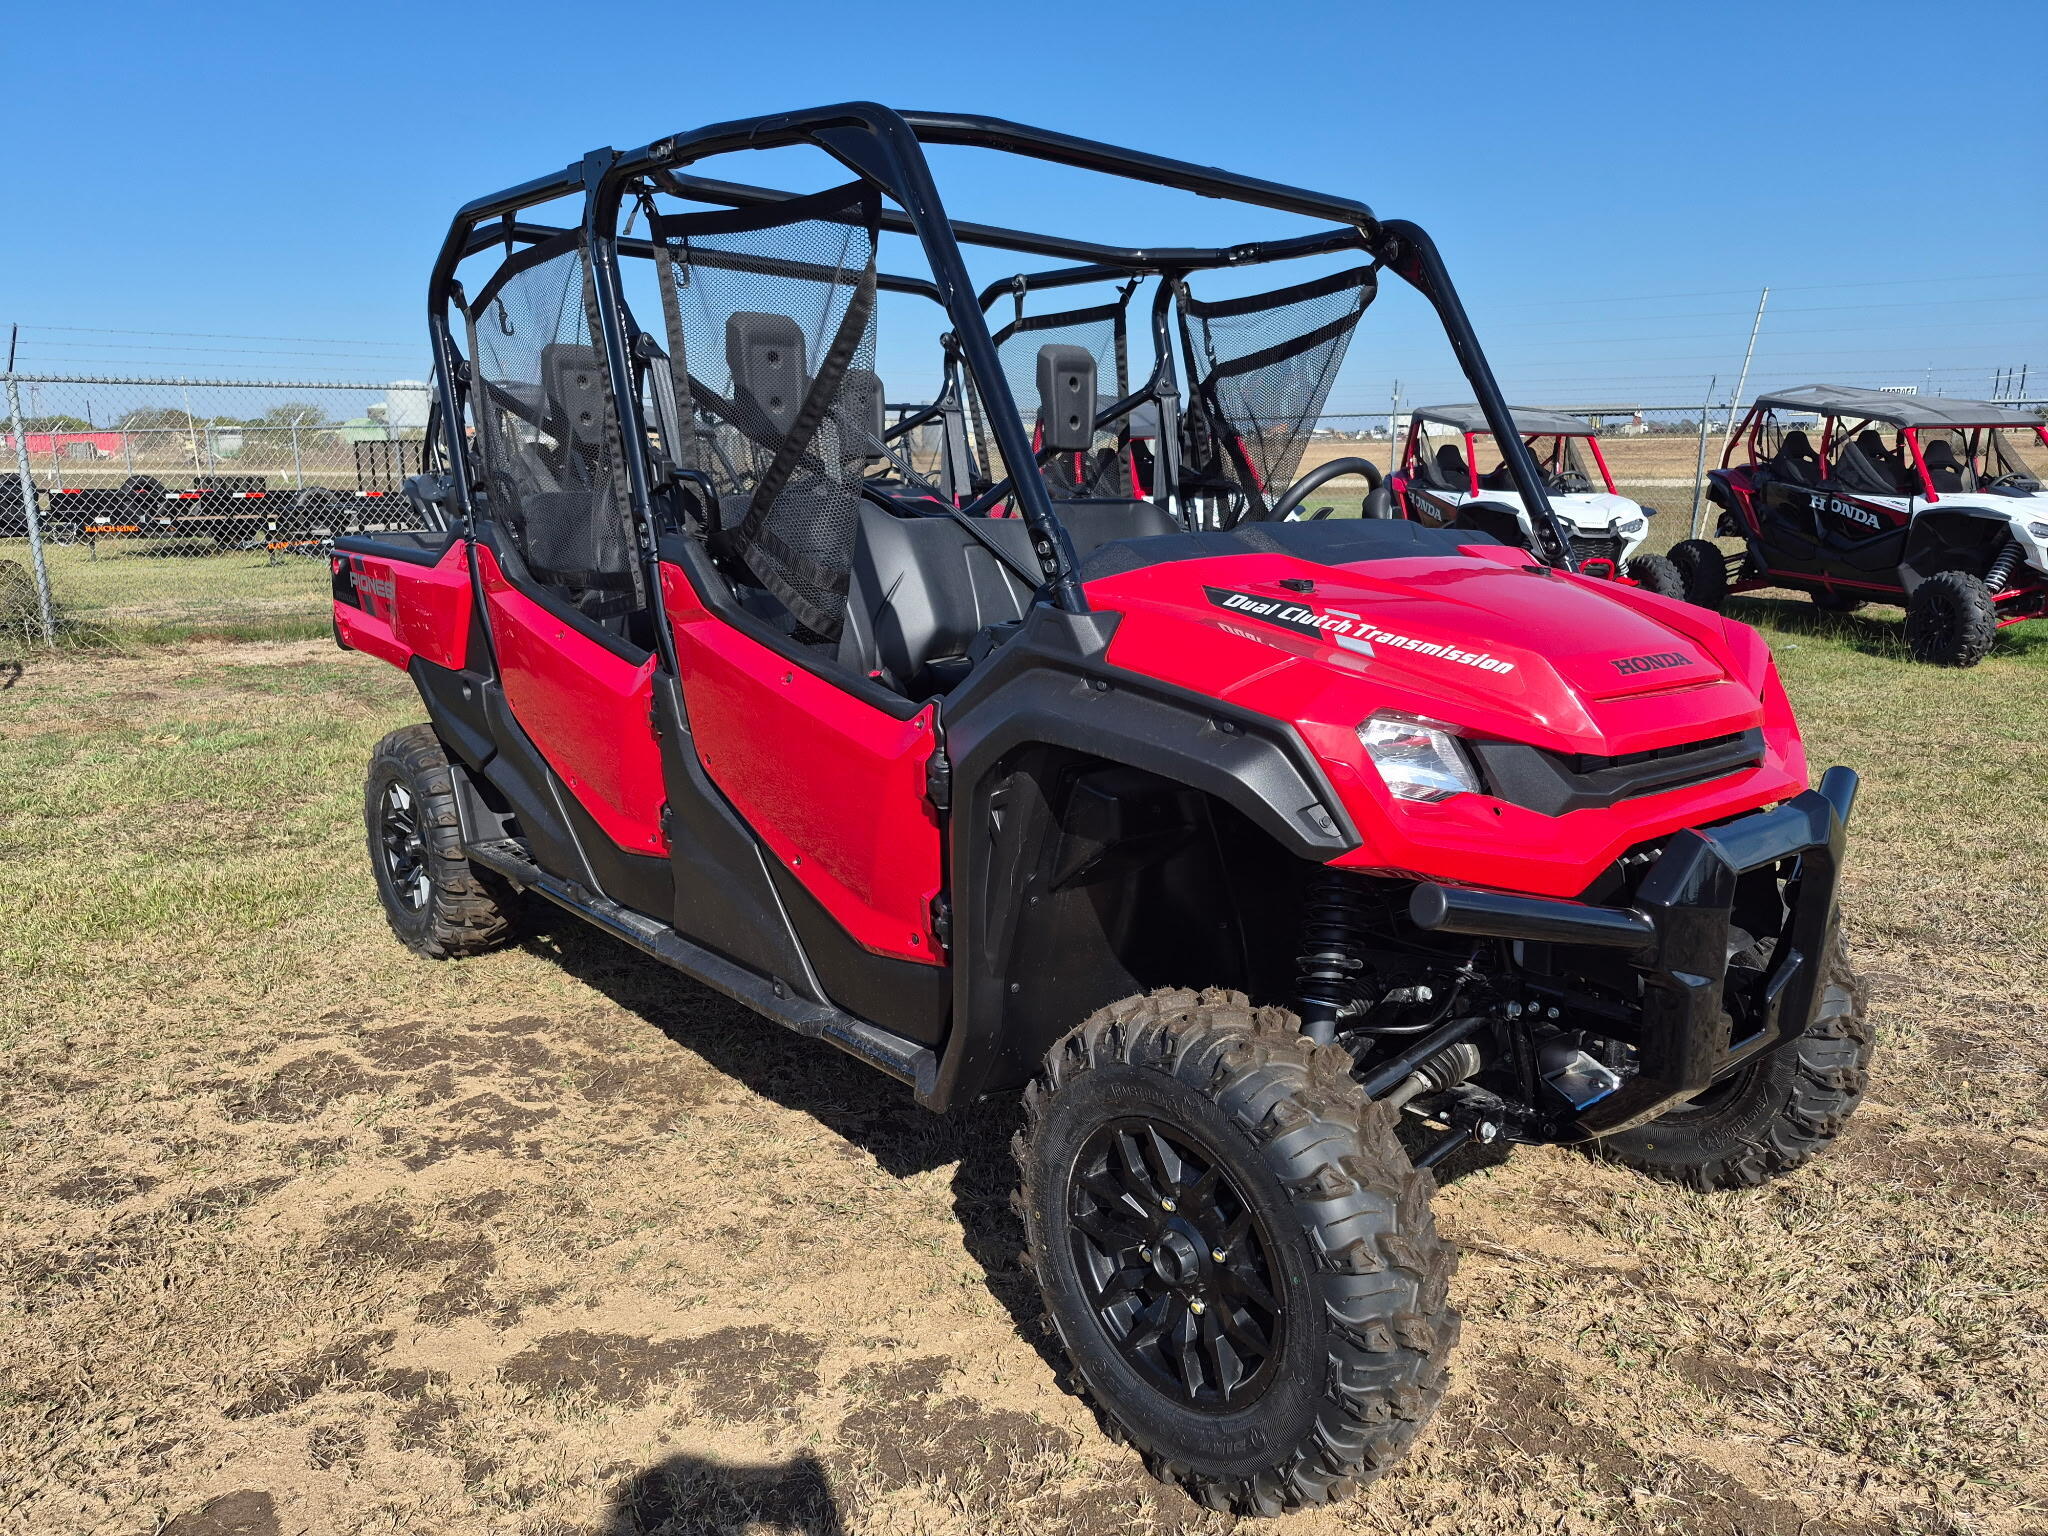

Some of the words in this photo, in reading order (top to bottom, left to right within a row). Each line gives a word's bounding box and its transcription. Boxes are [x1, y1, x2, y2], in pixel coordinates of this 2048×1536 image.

[1809, 495, 1881, 529] HONDA
[349, 571, 395, 600] PIONEE
[1223, 594, 1282, 616] Dual
[1277, 606, 1354, 634] Clutch
[1350, 623, 1516, 675] Transmission
[1610, 652, 1694, 675] HONDA
